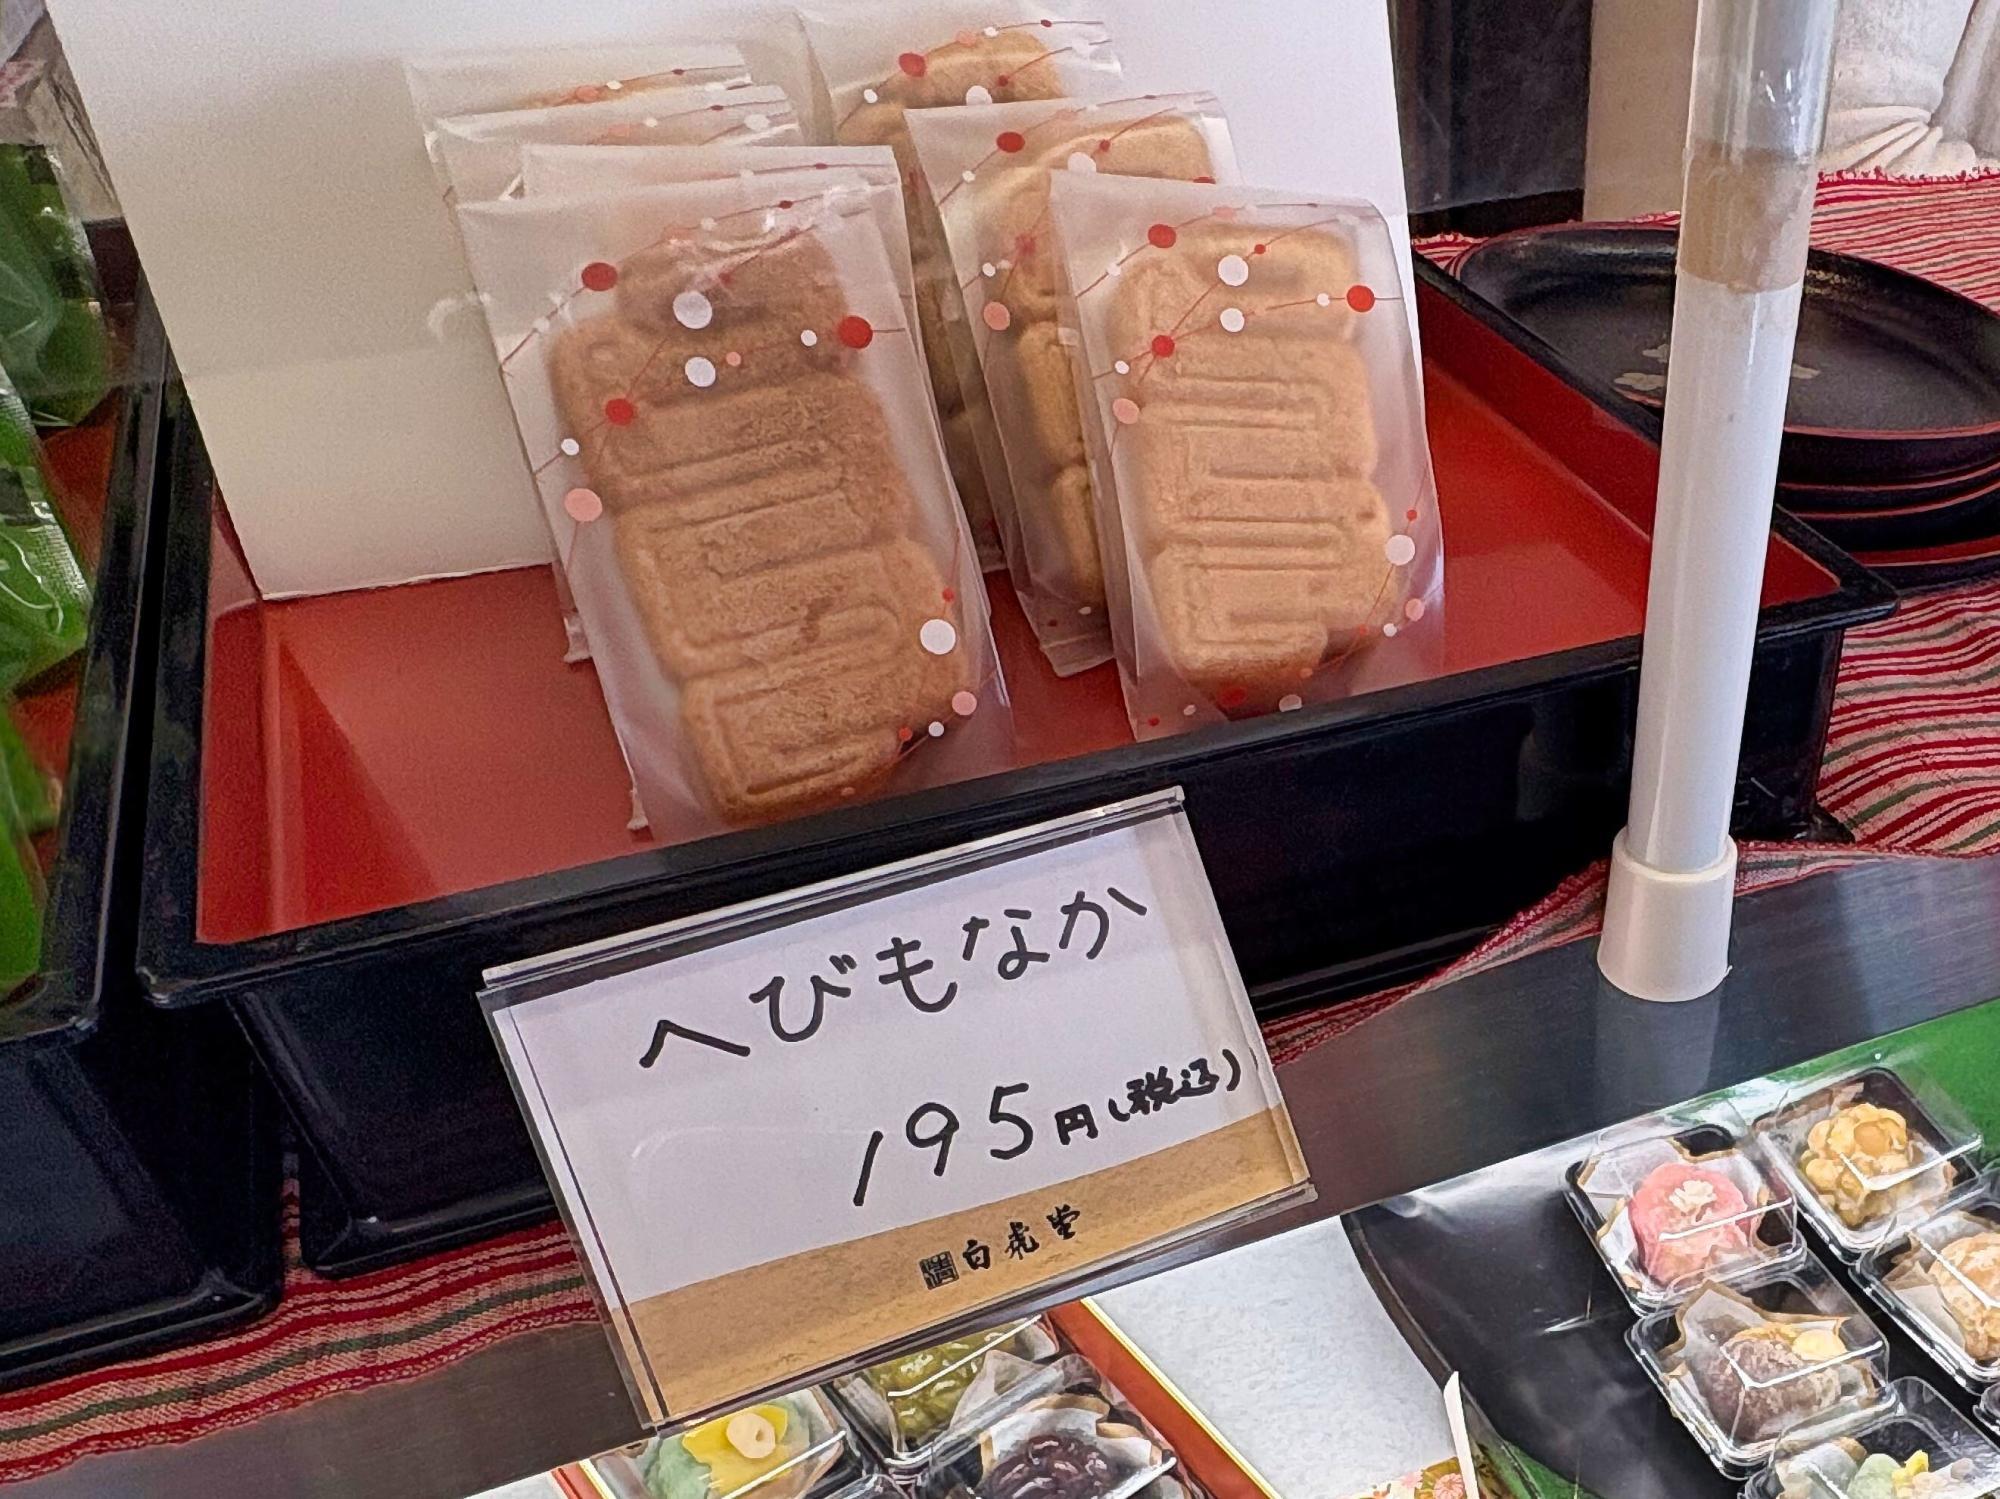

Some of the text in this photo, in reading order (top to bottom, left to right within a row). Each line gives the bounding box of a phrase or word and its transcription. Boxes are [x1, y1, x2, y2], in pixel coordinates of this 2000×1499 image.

[638, 886, 1148, 1069] へびもなか
